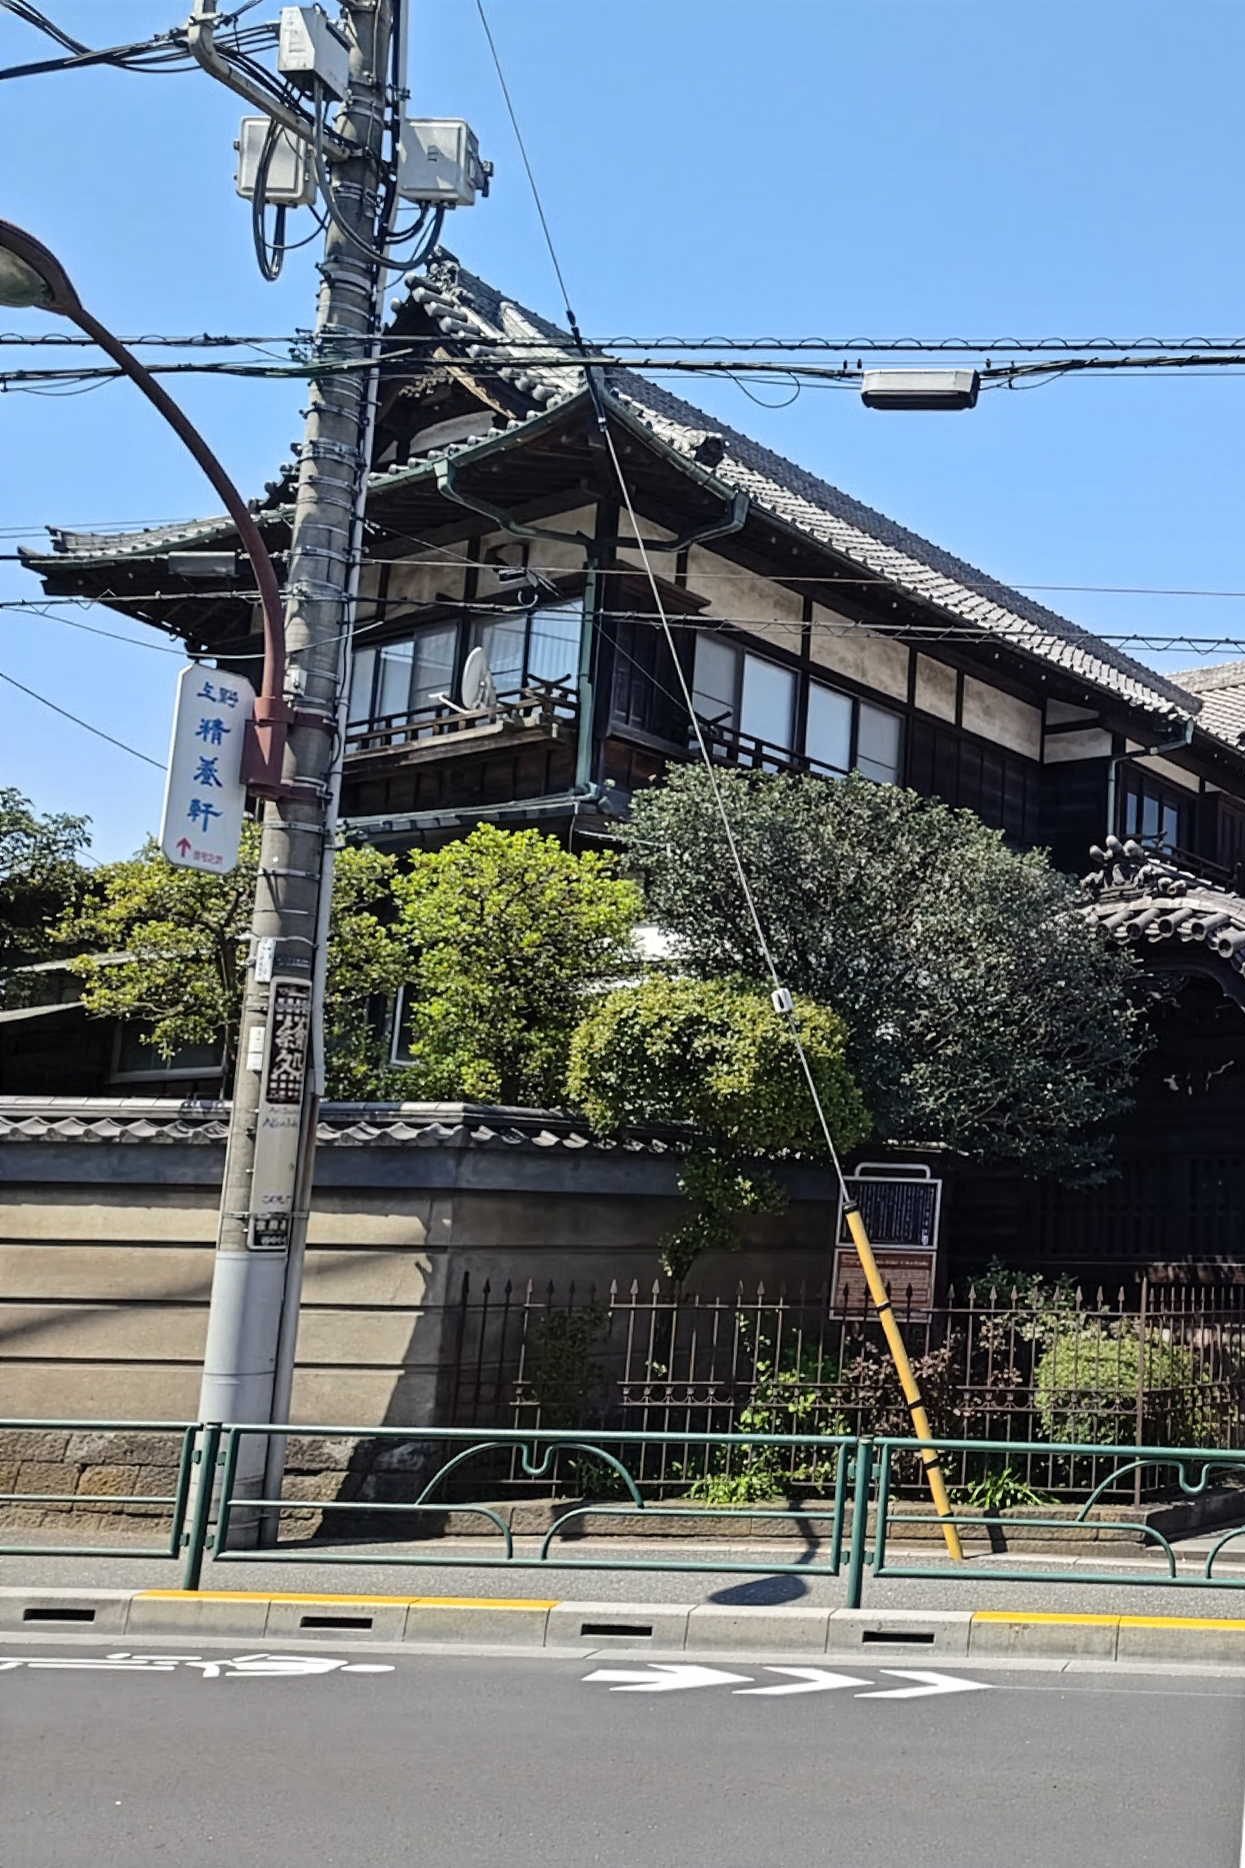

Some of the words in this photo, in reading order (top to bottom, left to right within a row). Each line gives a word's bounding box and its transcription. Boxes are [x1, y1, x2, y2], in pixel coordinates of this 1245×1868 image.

[196, 681, 239, 708] 上野
[187, 718, 231, 833] 精養軒
